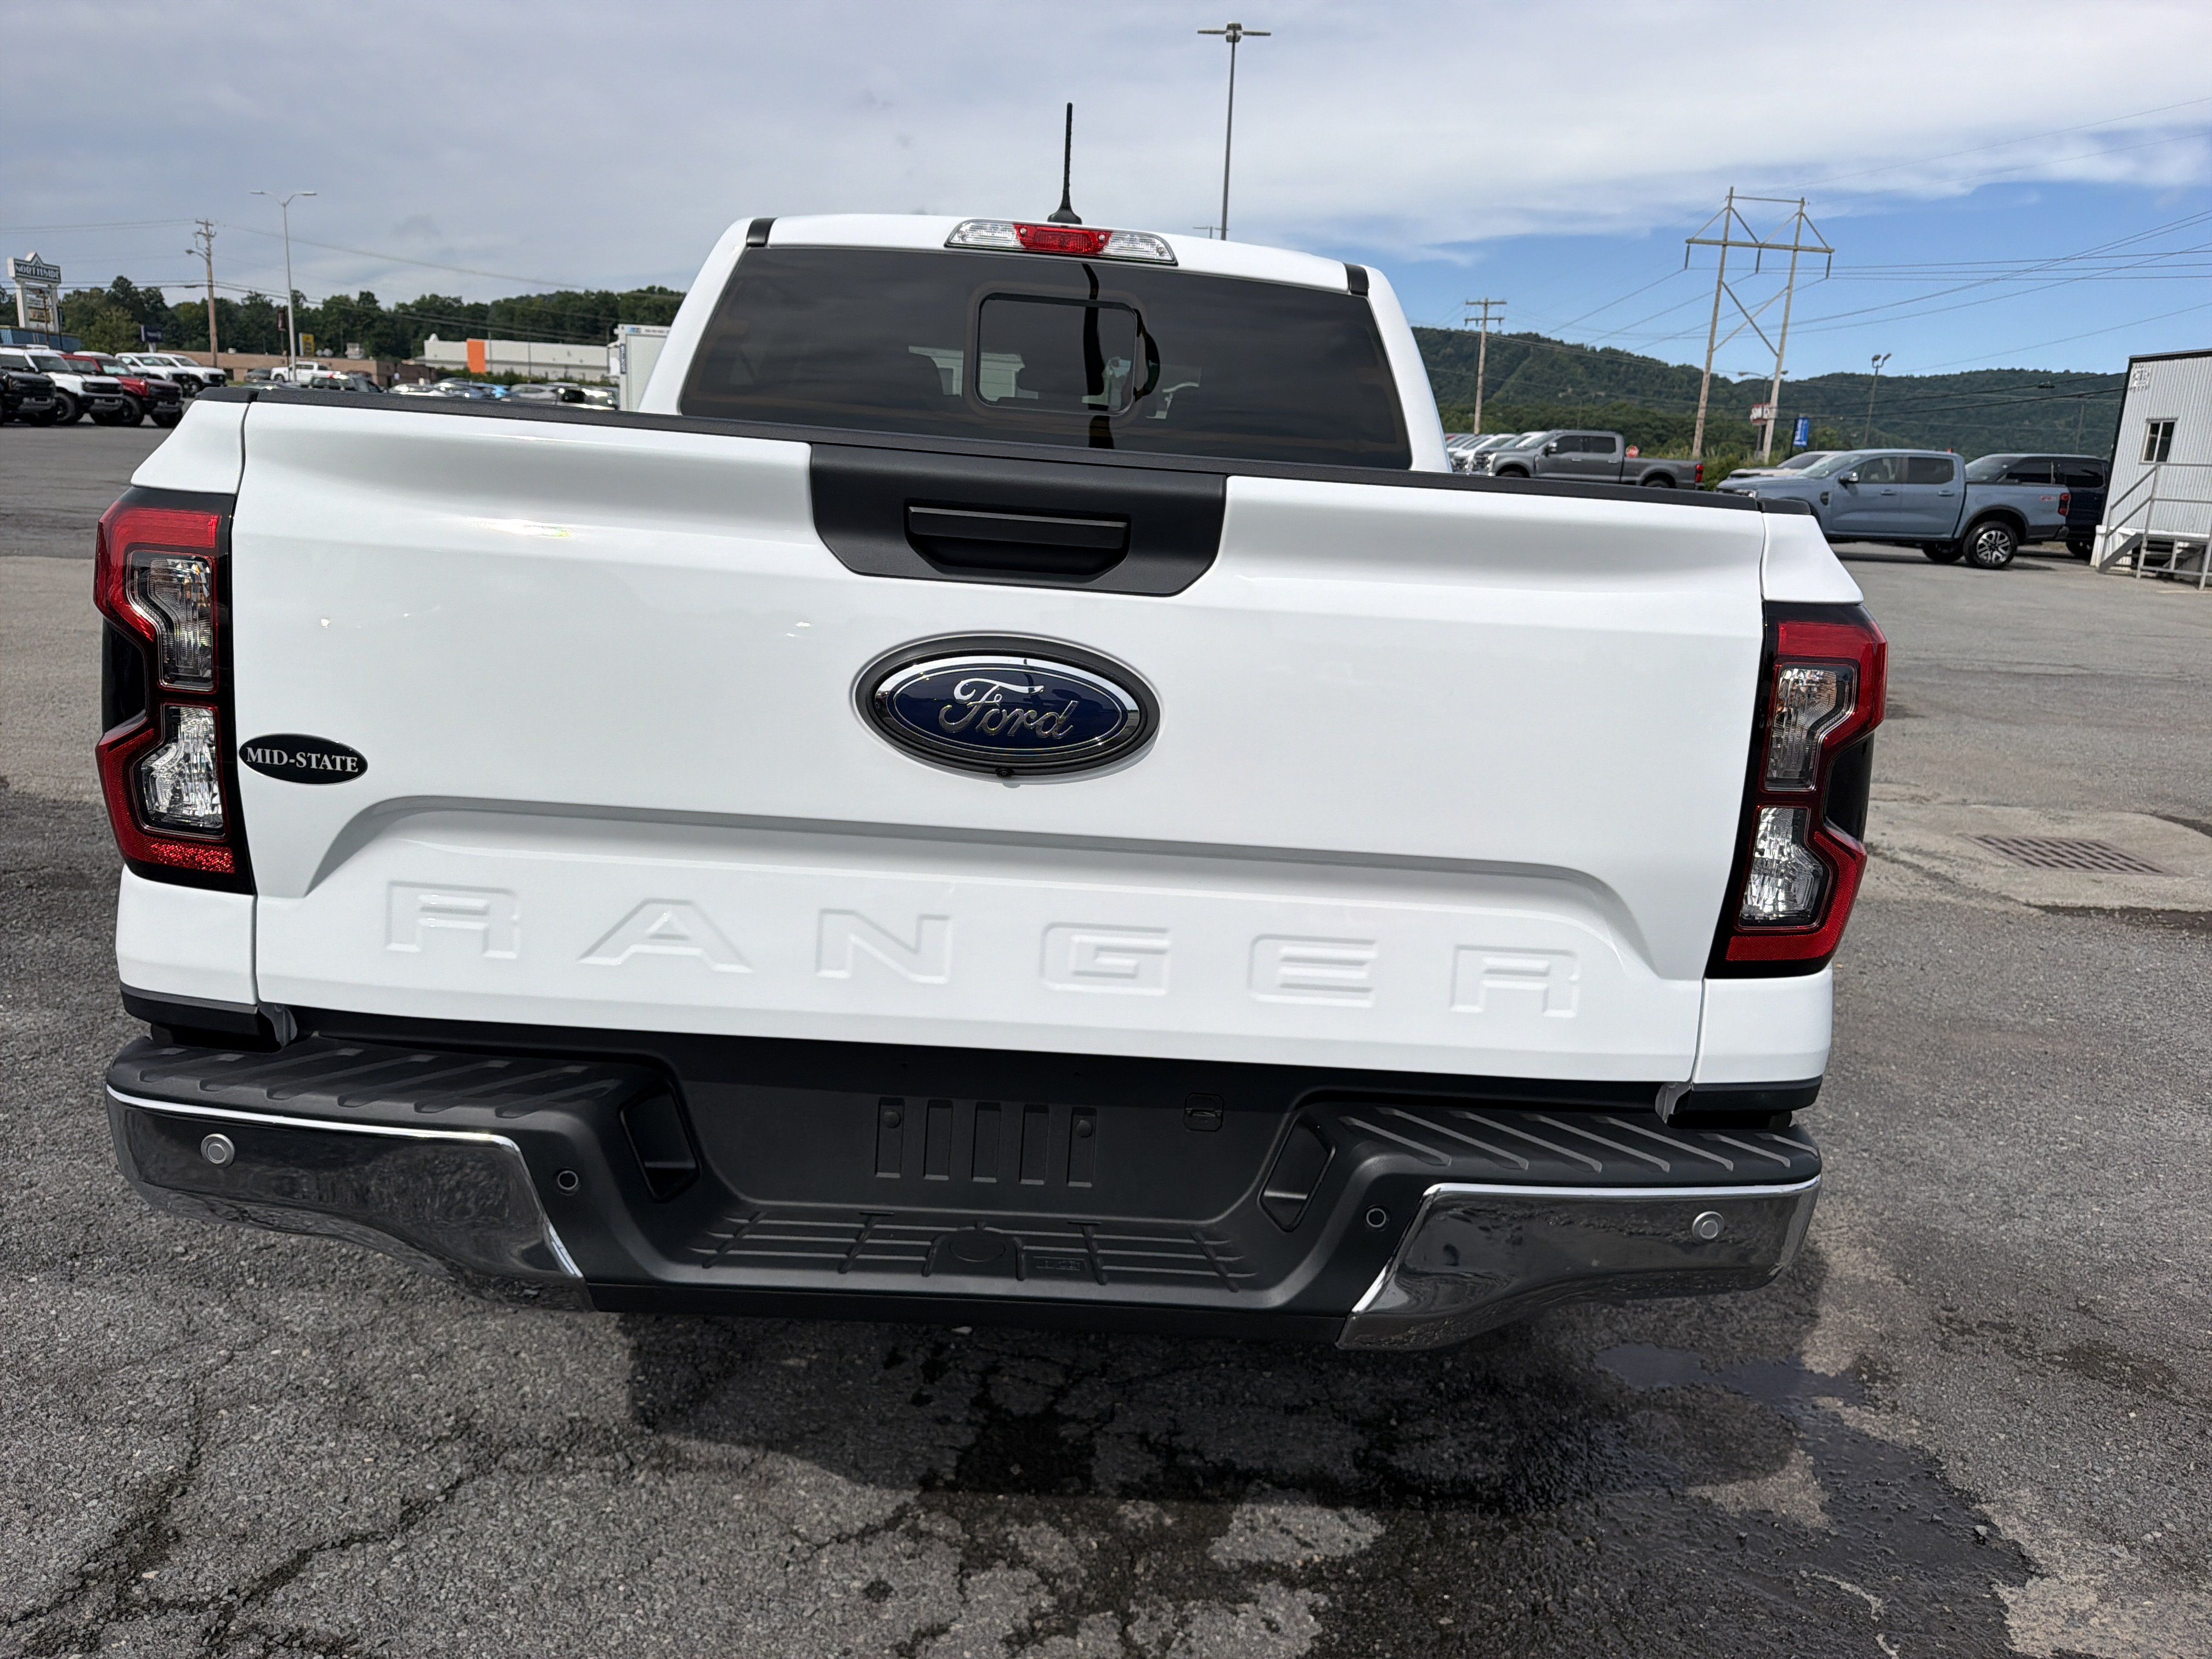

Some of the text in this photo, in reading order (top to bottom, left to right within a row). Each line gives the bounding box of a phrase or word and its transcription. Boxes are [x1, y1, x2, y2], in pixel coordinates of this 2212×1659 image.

[939, 678, 1079, 739] Ford
[246, 747, 358, 772] MID-STATE
[386, 880, 1581, 1018] RANGER
